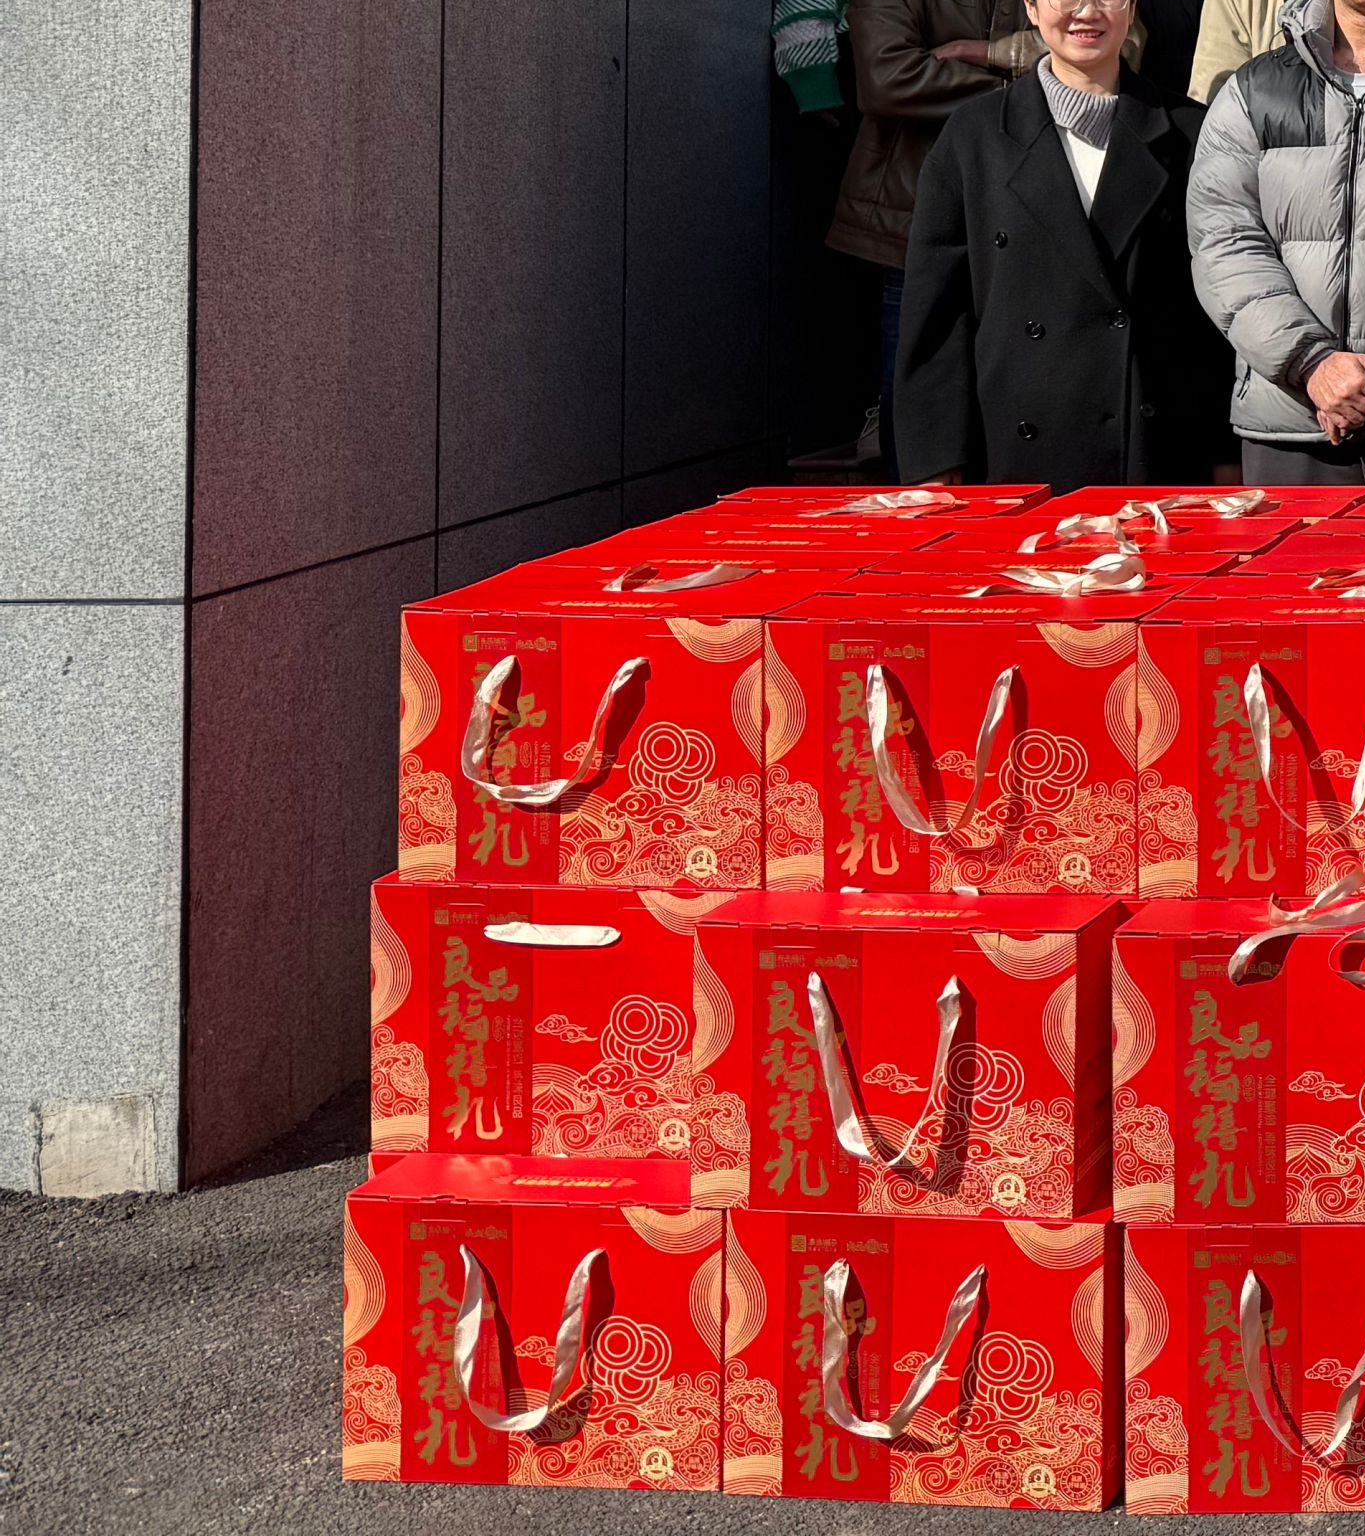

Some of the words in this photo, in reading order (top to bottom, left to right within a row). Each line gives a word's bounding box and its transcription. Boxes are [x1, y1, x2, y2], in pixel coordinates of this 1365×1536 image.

[761, 980, 847, 1196] 良福禧礼
[1184, 990, 1271, 1208] 良品福禧礼
[414, 1248, 492, 1468] 良福禧礼
